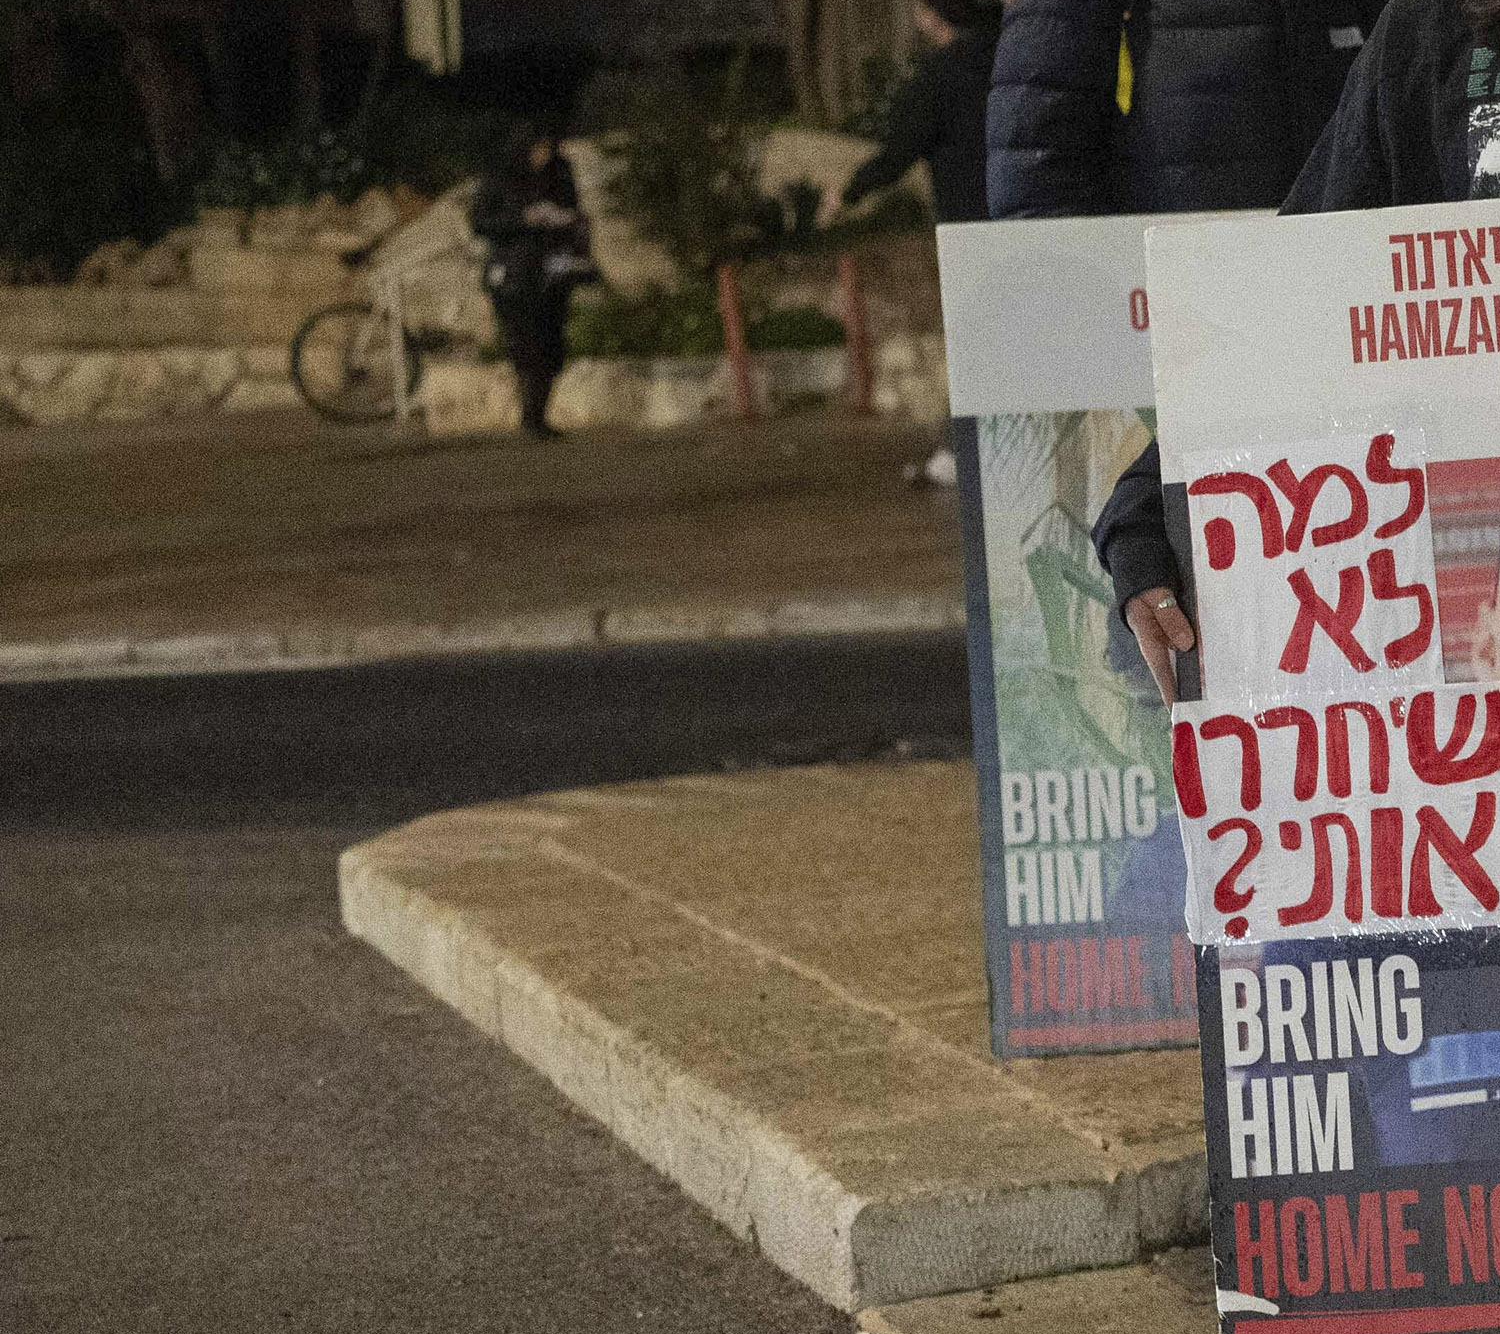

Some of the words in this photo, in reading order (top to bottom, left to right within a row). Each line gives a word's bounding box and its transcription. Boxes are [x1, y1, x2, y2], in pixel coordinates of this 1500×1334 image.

[1188, 433, 1426, 570] למה
[1278, 548, 1435, 674] לא
[1002, 766, 1157, 846] BRING
[1004, 849, 1104, 928] HIM
[1208, 791, 1500, 938] אותי?
[1009, 935, 1155, 1015] HOME
[1220, 954, 1424, 1068] BRING
[1227, 1071, 1354, 1179] HIM
[1233, 1189, 1425, 1299] HOME
